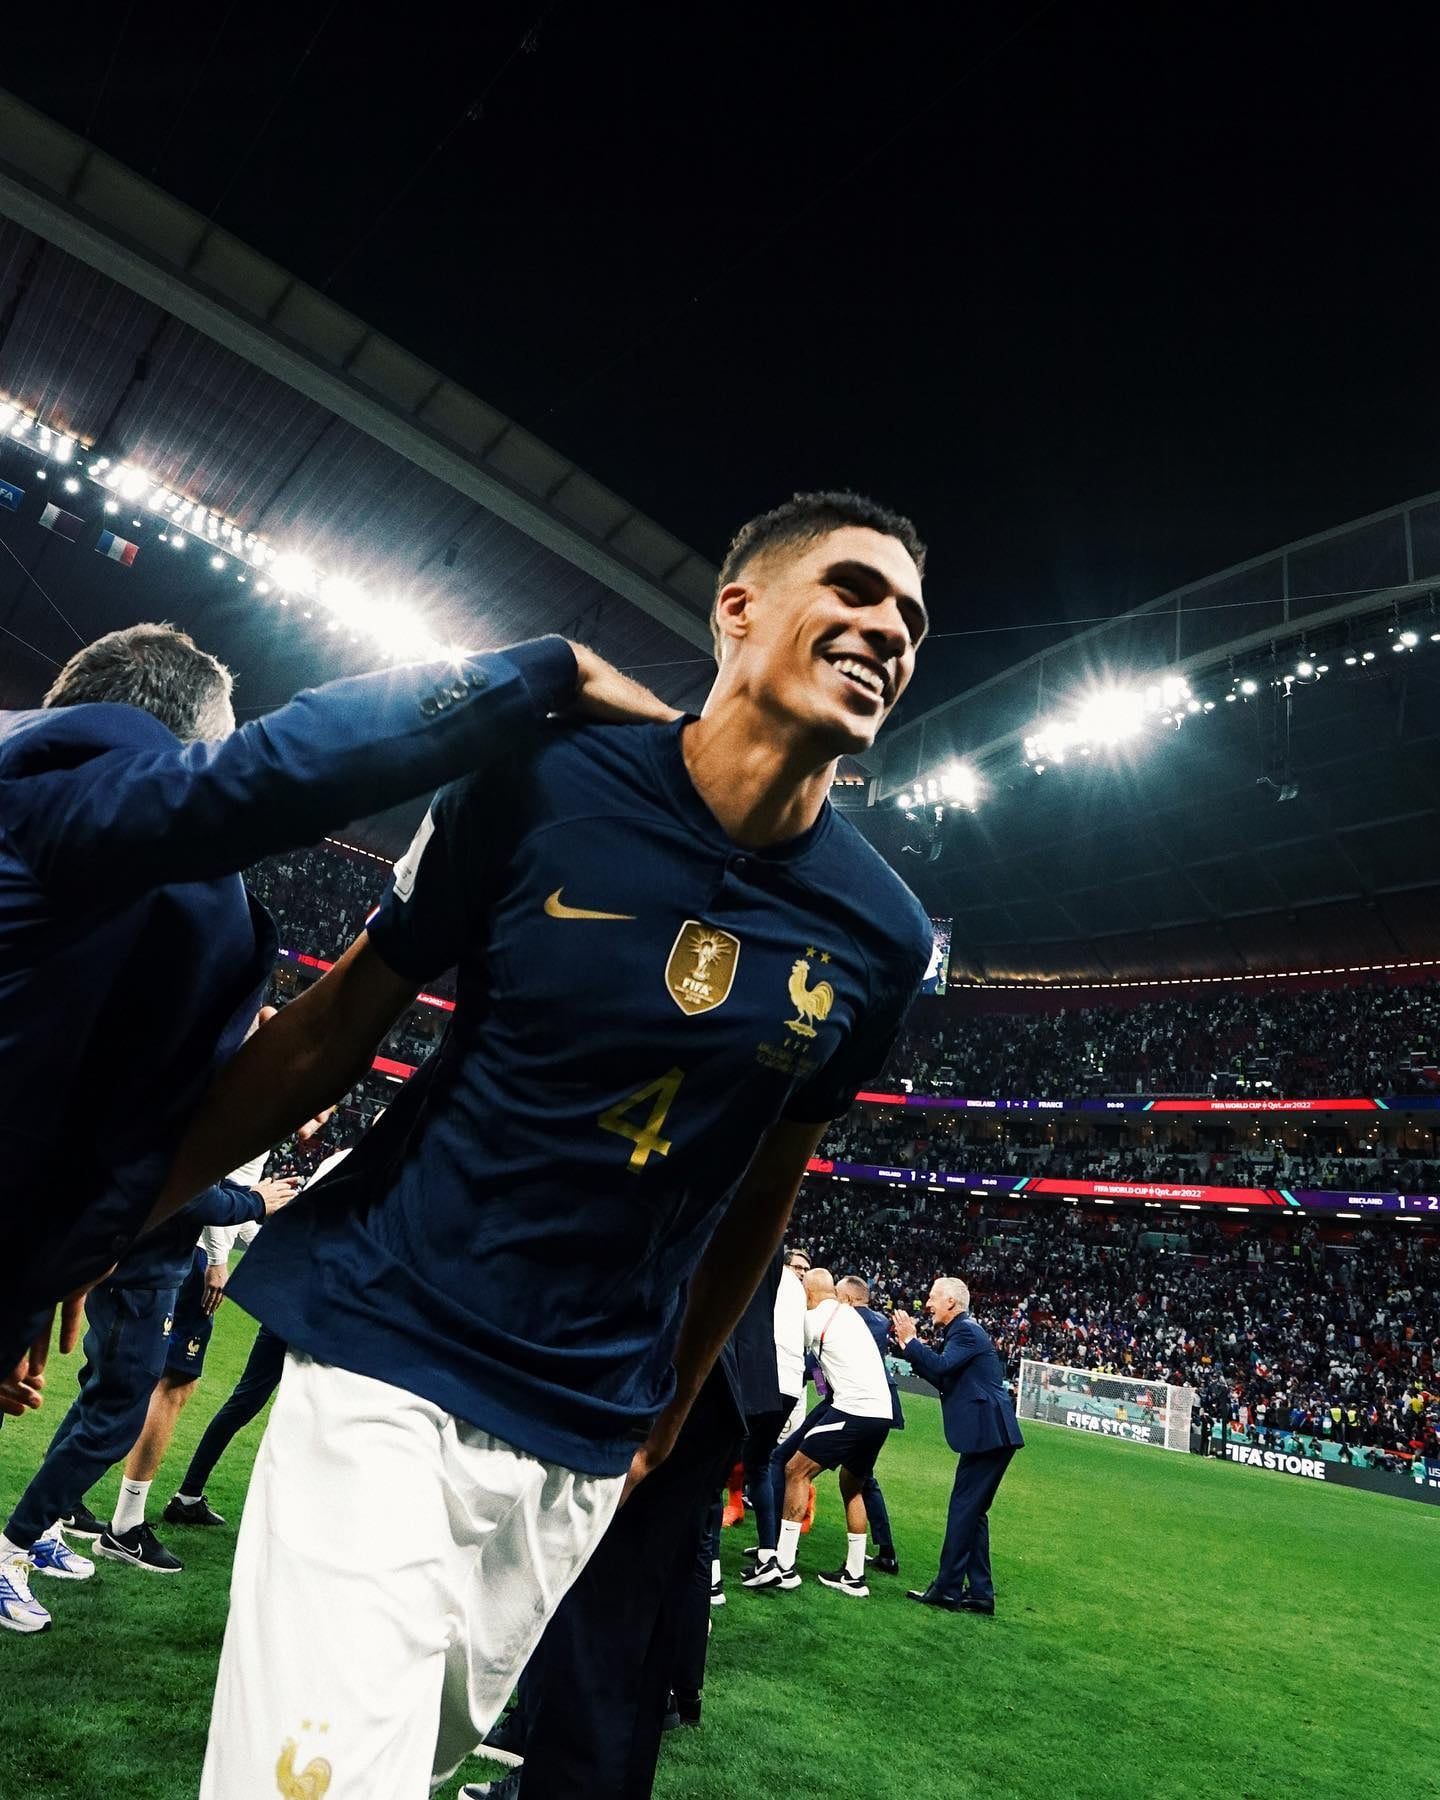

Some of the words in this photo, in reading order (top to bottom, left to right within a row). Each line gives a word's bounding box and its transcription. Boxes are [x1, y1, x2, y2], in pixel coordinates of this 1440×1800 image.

[682, 977, 710, 996] FIFA
[966, 1100, 996, 1108] ENGLAND
[1006, 1100, 1011, 1108] 1
[1022, 1100, 1028, 1108] 2
[1038, 1101, 1064, 1109] FRANCE
[598, 1067, 685, 1174] 4
[878, 1170, 902, 1178] ENGLAND
[910, 1170, 916, 1181] 1
[929, 1172, 937, 1182] 2
[946, 1176, 966, 1184] FRANCE
[1094, 1185, 1109, 1193] FIFA
[1109, 1186, 1134, 1194] WORLD
[1134, 1187, 1149, 1195] CUP
[1348, 1197, 1383, 1206] ENGLAND
[1397, 1196, 1406, 1209] 1
[1427, 1197, 1439, 1210] 2
[1066, 1411, 1100, 1430] FIFA
[1264, 1451, 1326, 1480] STORE
